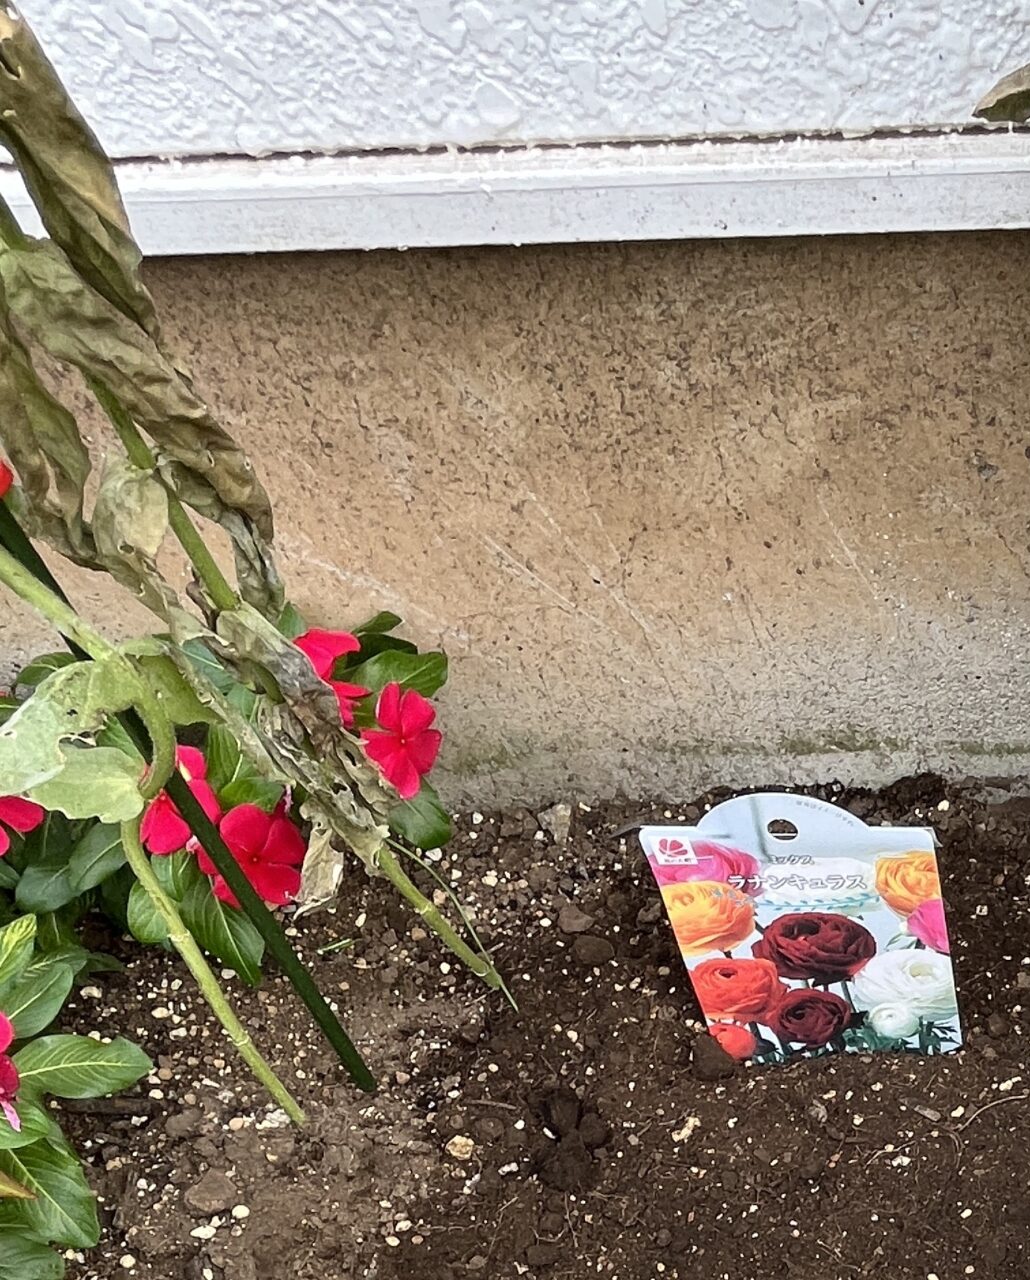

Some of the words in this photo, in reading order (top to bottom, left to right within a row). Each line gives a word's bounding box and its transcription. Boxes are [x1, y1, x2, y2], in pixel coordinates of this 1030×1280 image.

[727, 874, 867, 891] ラナンキュラス
